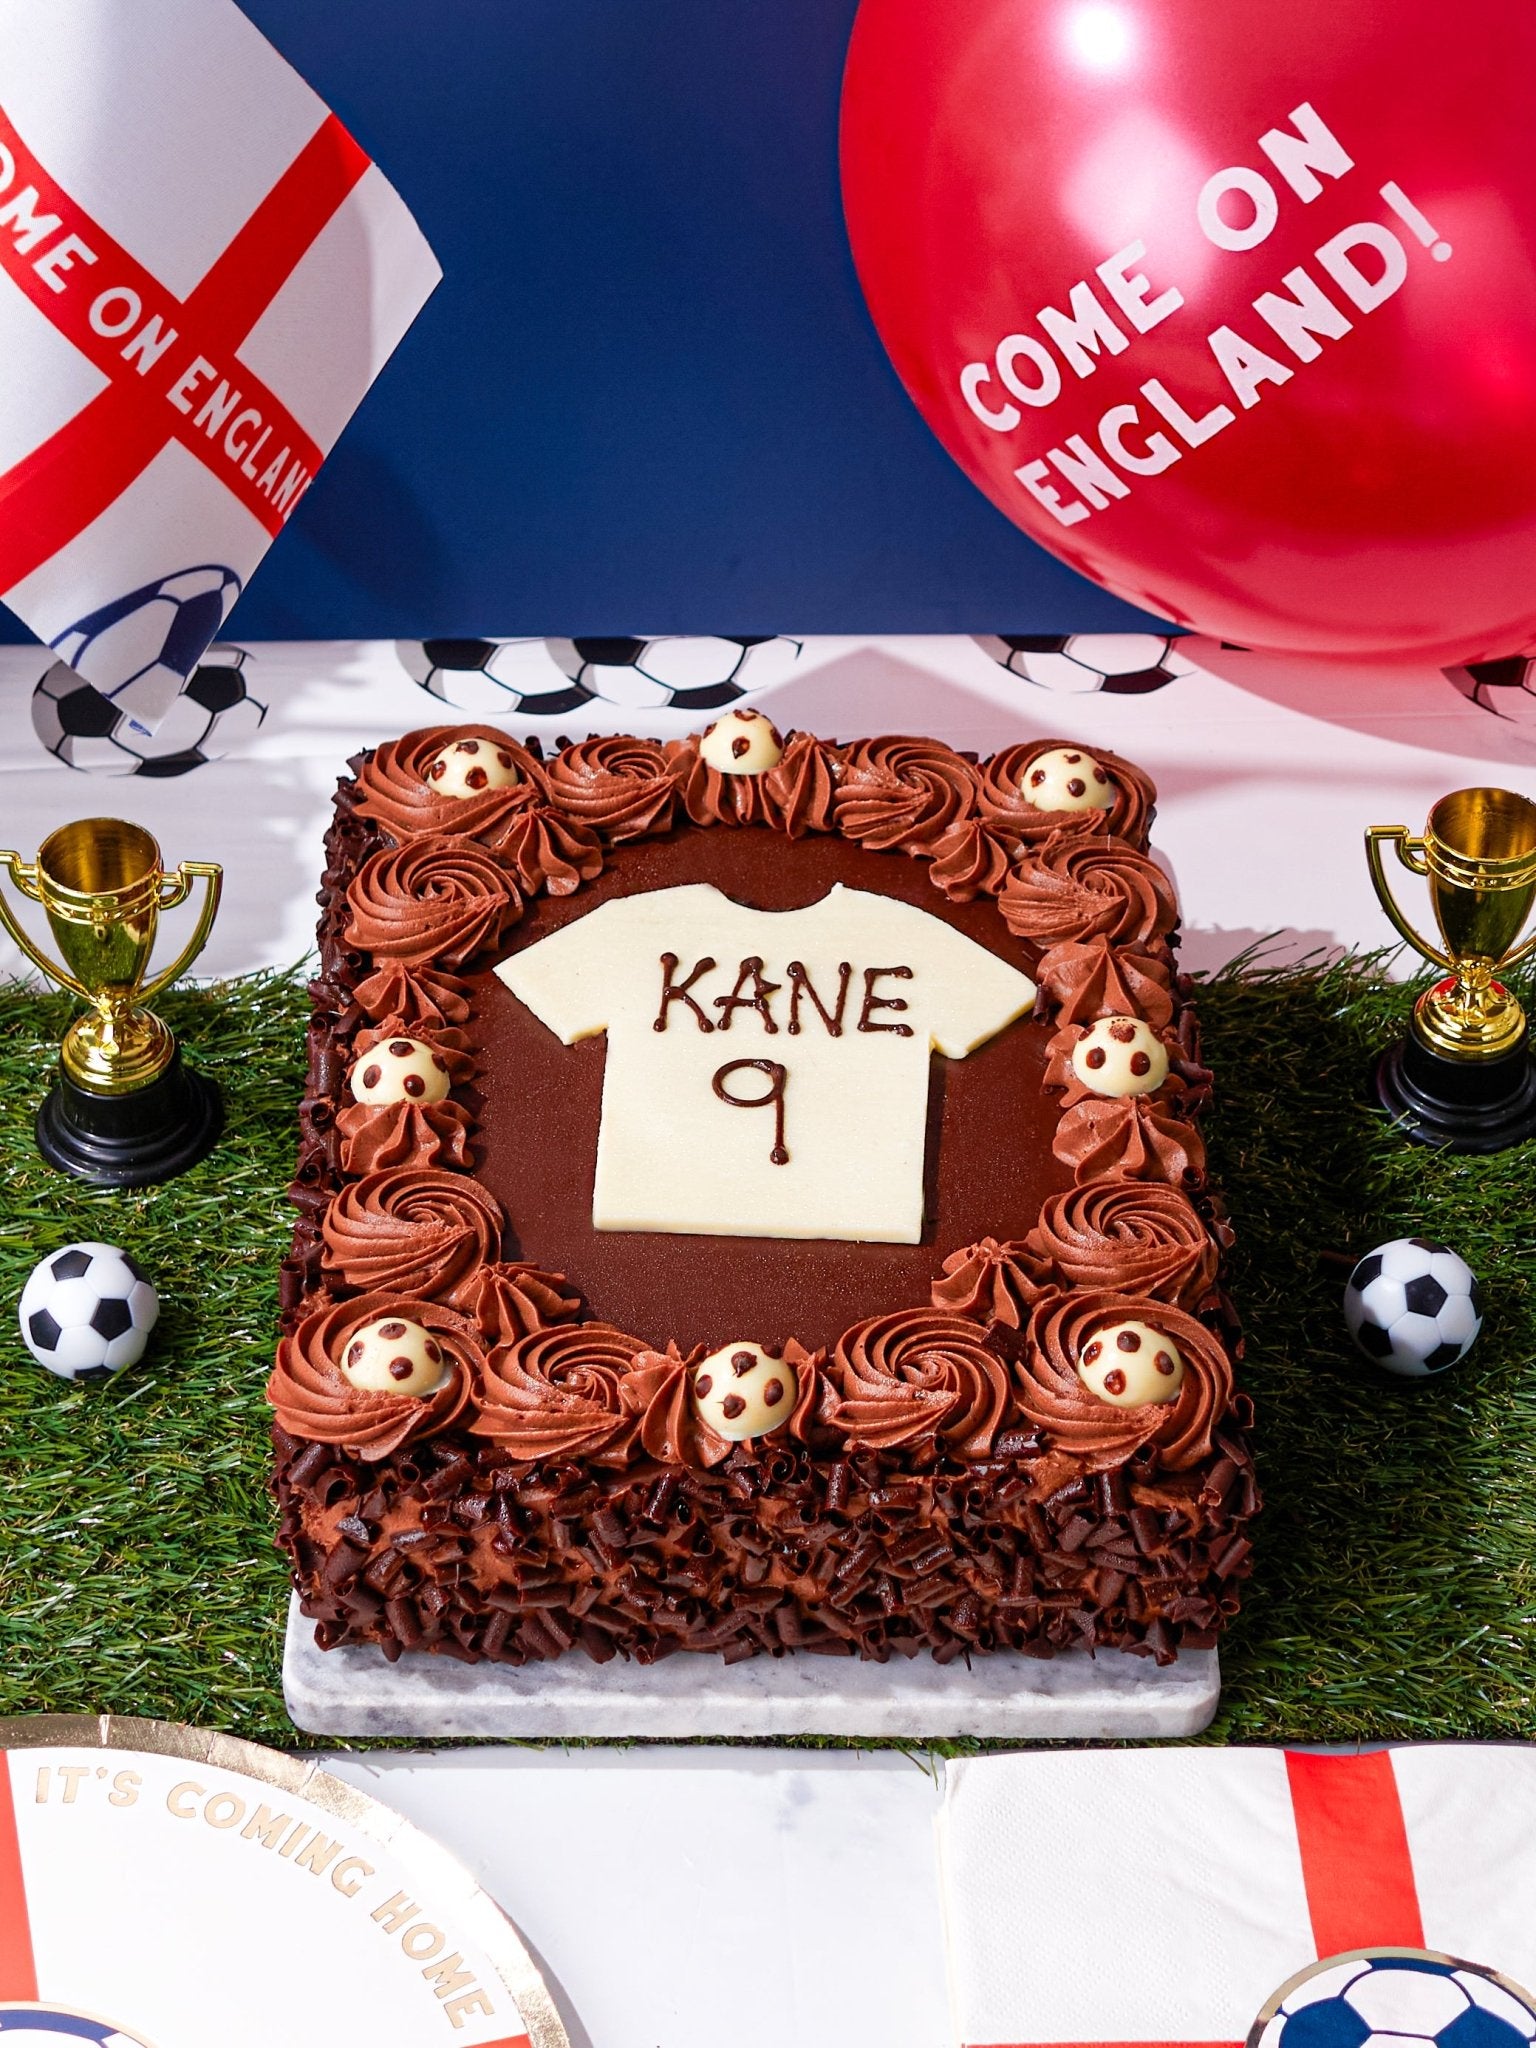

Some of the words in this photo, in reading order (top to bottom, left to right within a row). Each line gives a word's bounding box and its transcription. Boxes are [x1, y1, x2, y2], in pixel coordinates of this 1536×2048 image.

[89, 286, 179, 376] ON
[960, 239, 1184, 432] COME
[1197, 101, 1355, 252] ON
[1014, 180, 1453, 526] ENGLAND!
[653, 952, 914, 1037] KANE
[712, 1058, 789, 1166] 9
[35, 1766, 142, 1807] IT'S
[166, 1781, 375, 1898] COMING
[370, 1889, 495, 2029] HOME
